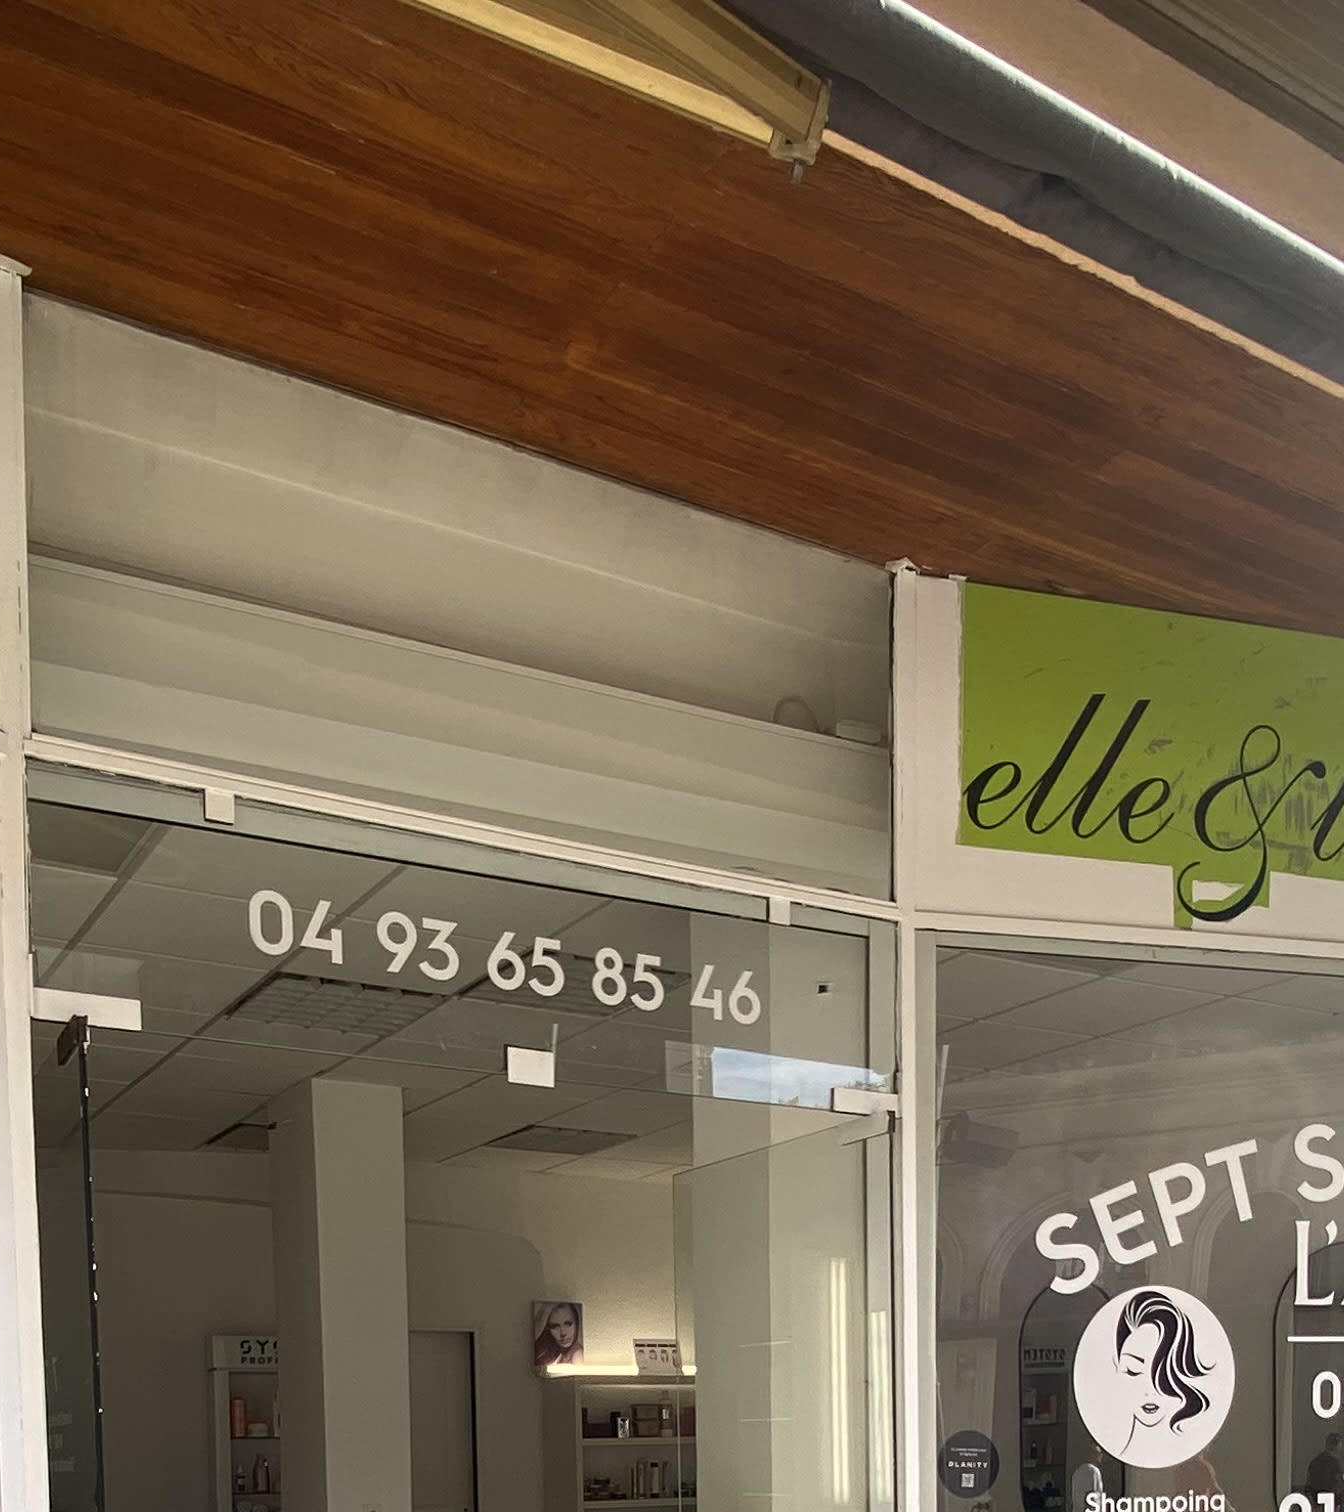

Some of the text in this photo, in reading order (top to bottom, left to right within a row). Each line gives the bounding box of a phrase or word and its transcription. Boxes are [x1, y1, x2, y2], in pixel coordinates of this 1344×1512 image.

[963, 694, 1175, 844] elle
[1178, 725, 1326, 922] &
[248, 890, 761, 1024] 04 93 65 85 46
[1035, 1139, 1257, 1295] SEPT
